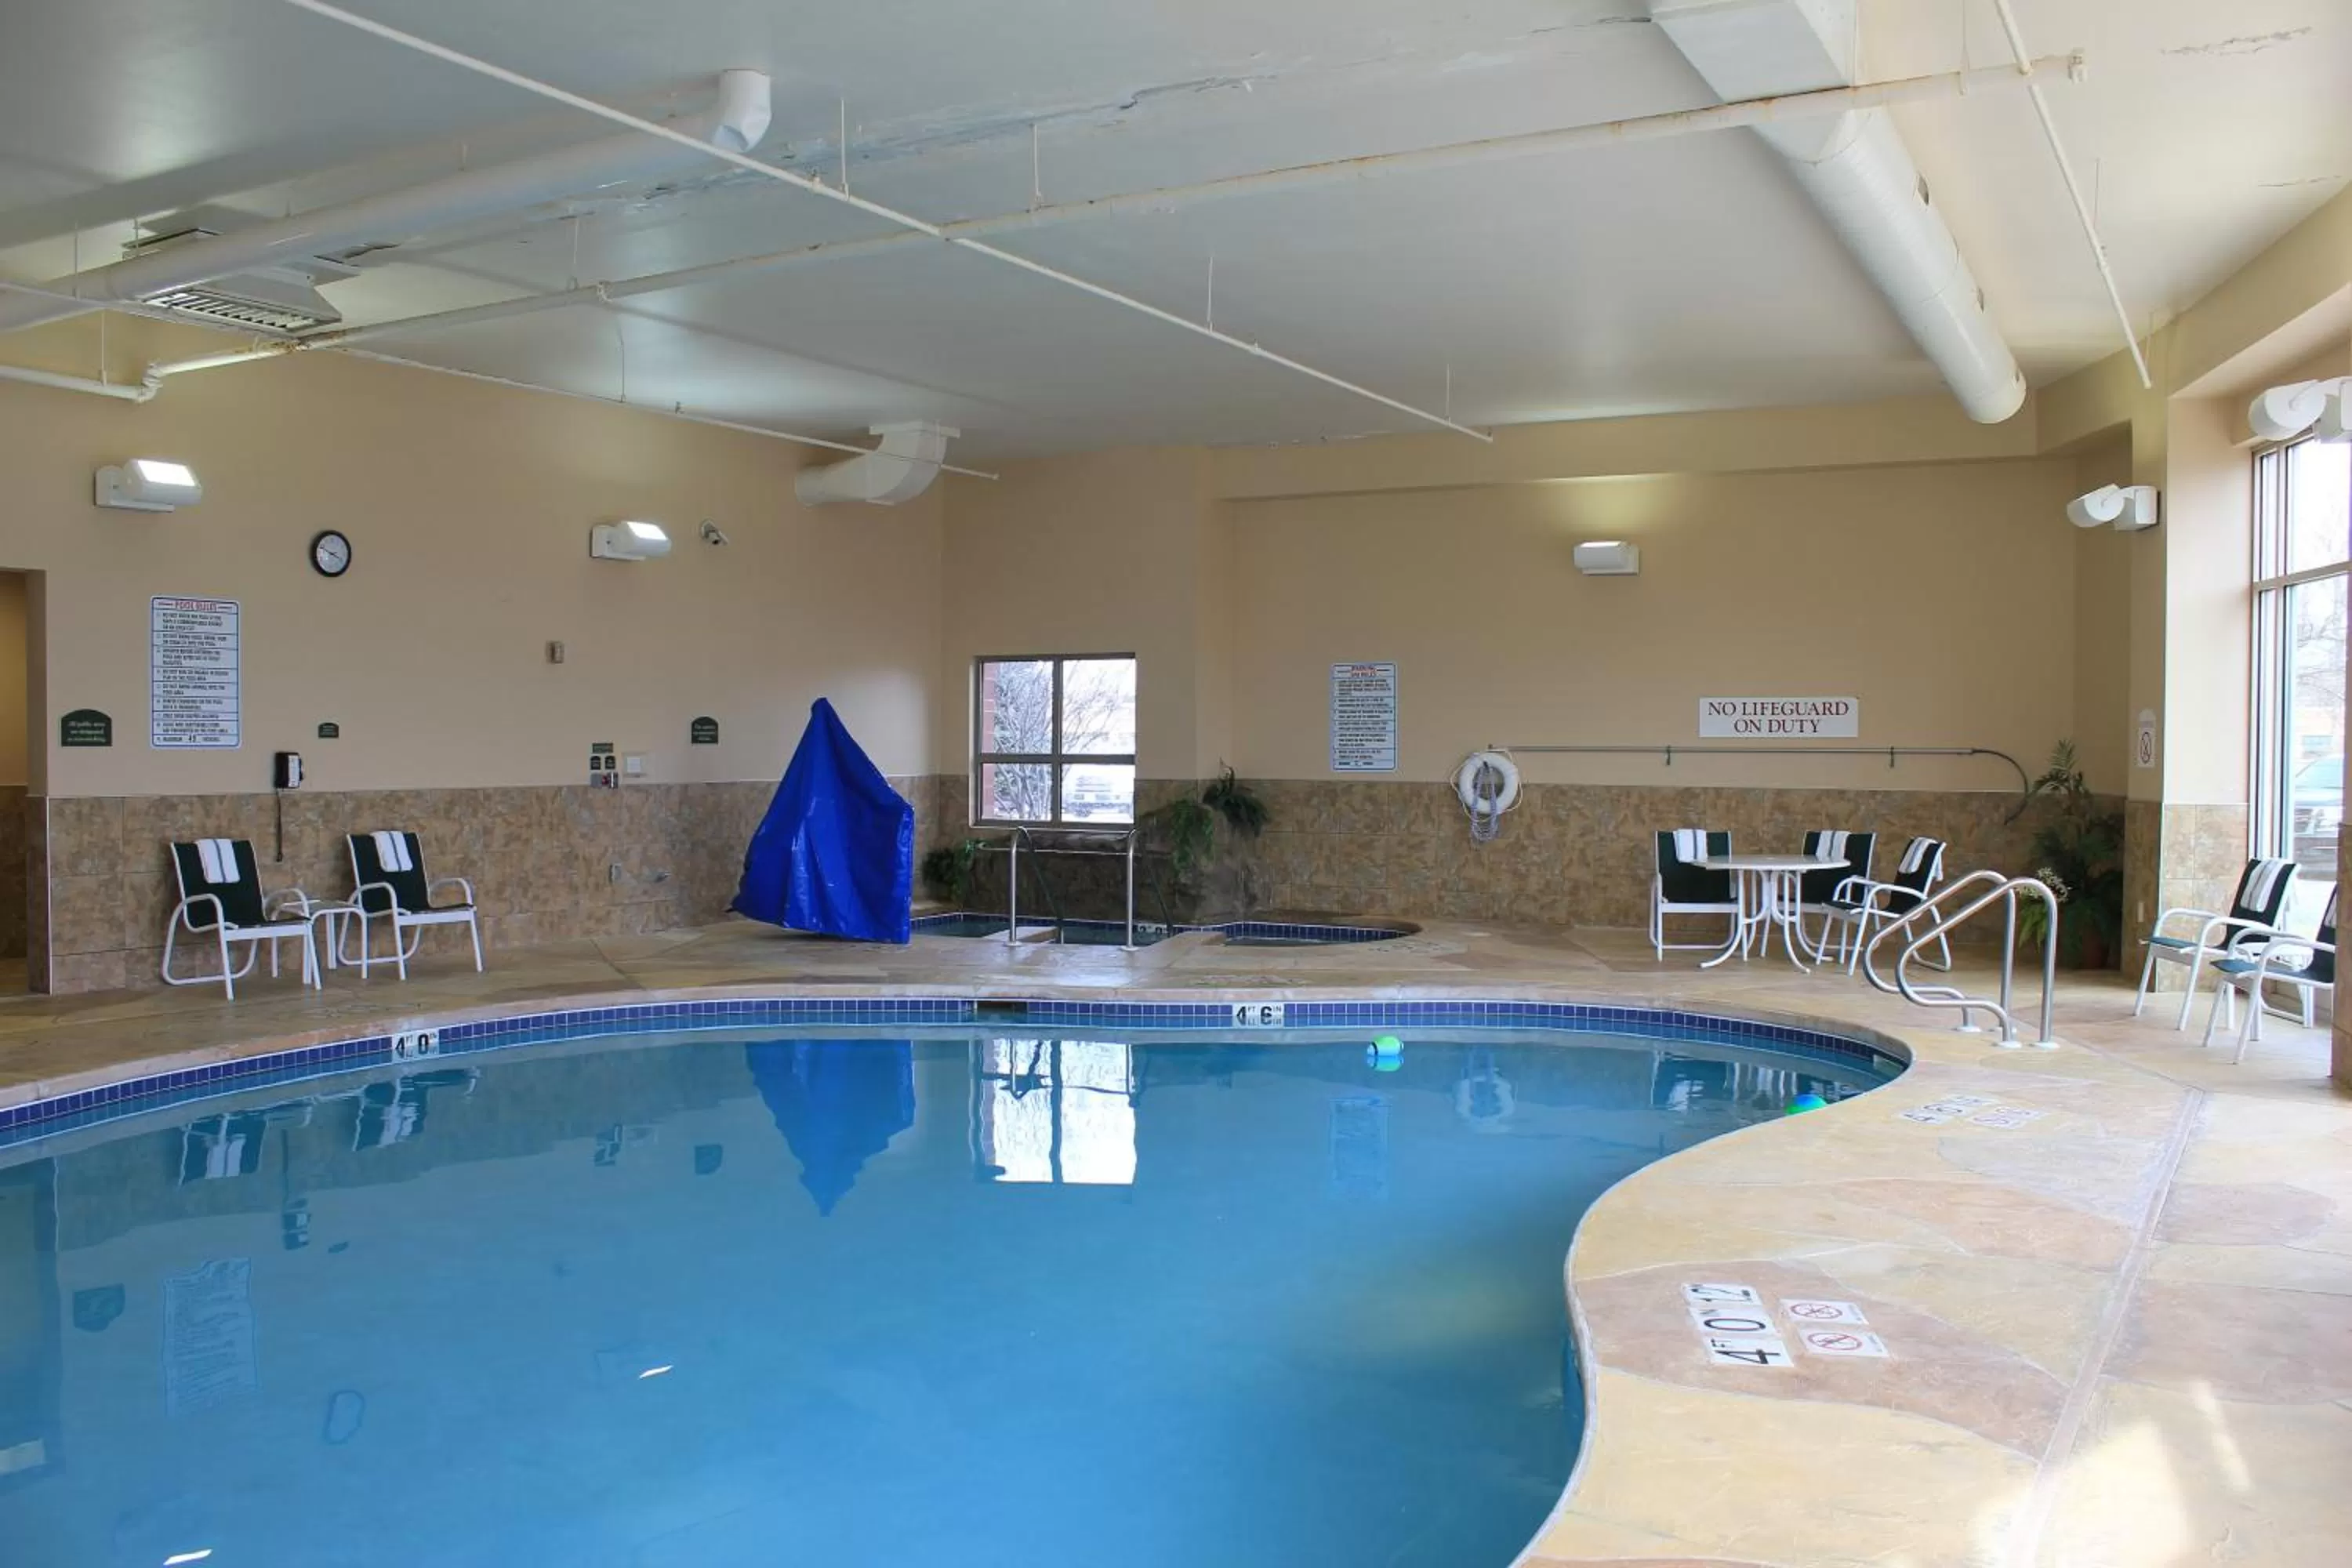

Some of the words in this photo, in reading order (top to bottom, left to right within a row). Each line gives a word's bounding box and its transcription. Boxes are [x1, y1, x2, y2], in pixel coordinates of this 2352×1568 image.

[1708, 702, 1737, 715] NO
[1742, 702, 1849, 716] LIFEGUARD
[1733, 719, 1762, 732] ON
[1768, 719, 1820, 733] DUTY
[1703, 1318, 1766, 1331] 0
[1714, 1348, 1781, 1365] 4
